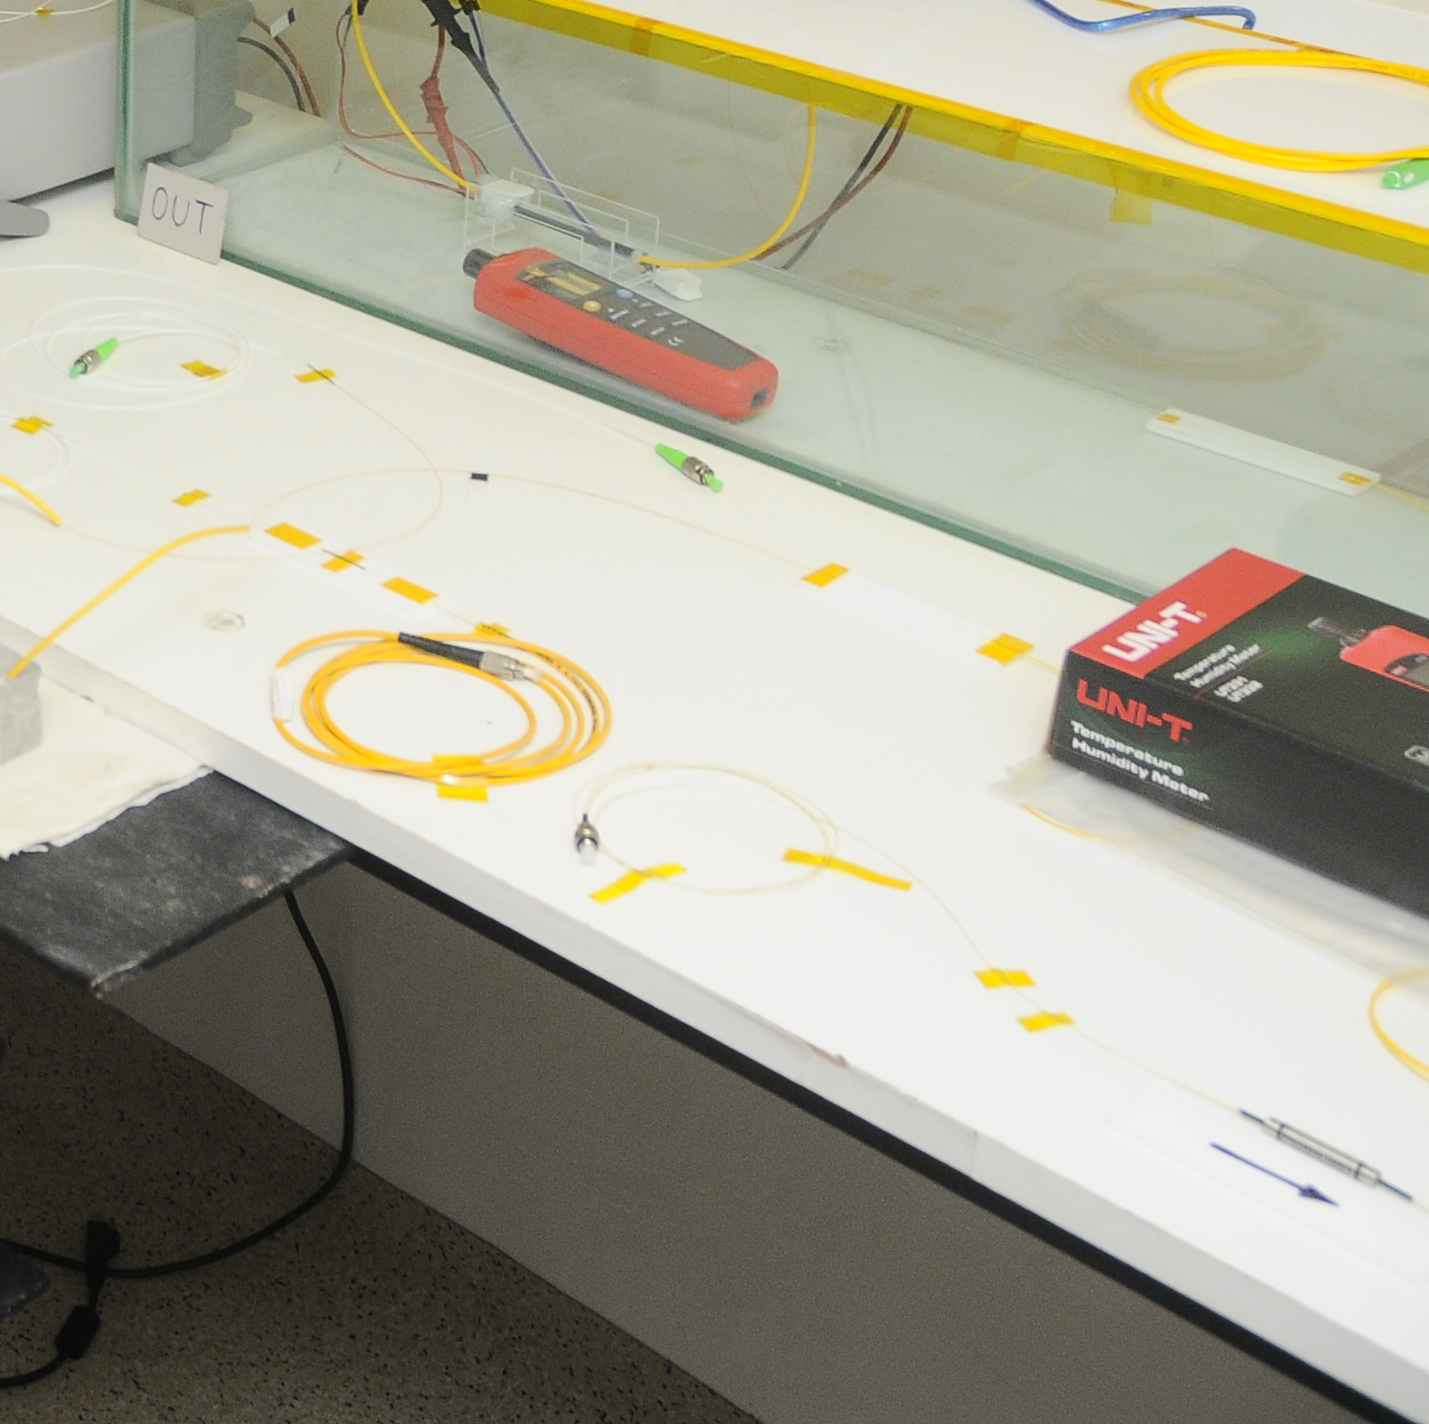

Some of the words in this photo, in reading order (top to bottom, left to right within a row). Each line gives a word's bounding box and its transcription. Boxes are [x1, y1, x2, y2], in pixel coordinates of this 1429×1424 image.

[152, 186, 214, 234] OUT
[1102, 600, 1202, 662] UNI-T
[1076, 678, 1194, 742] UNI-T
[1070, 720, 1185, 777] Temperature
[1071, 736, 1150, 780] Humidity
[1151, 770, 1211, 802] Meter
